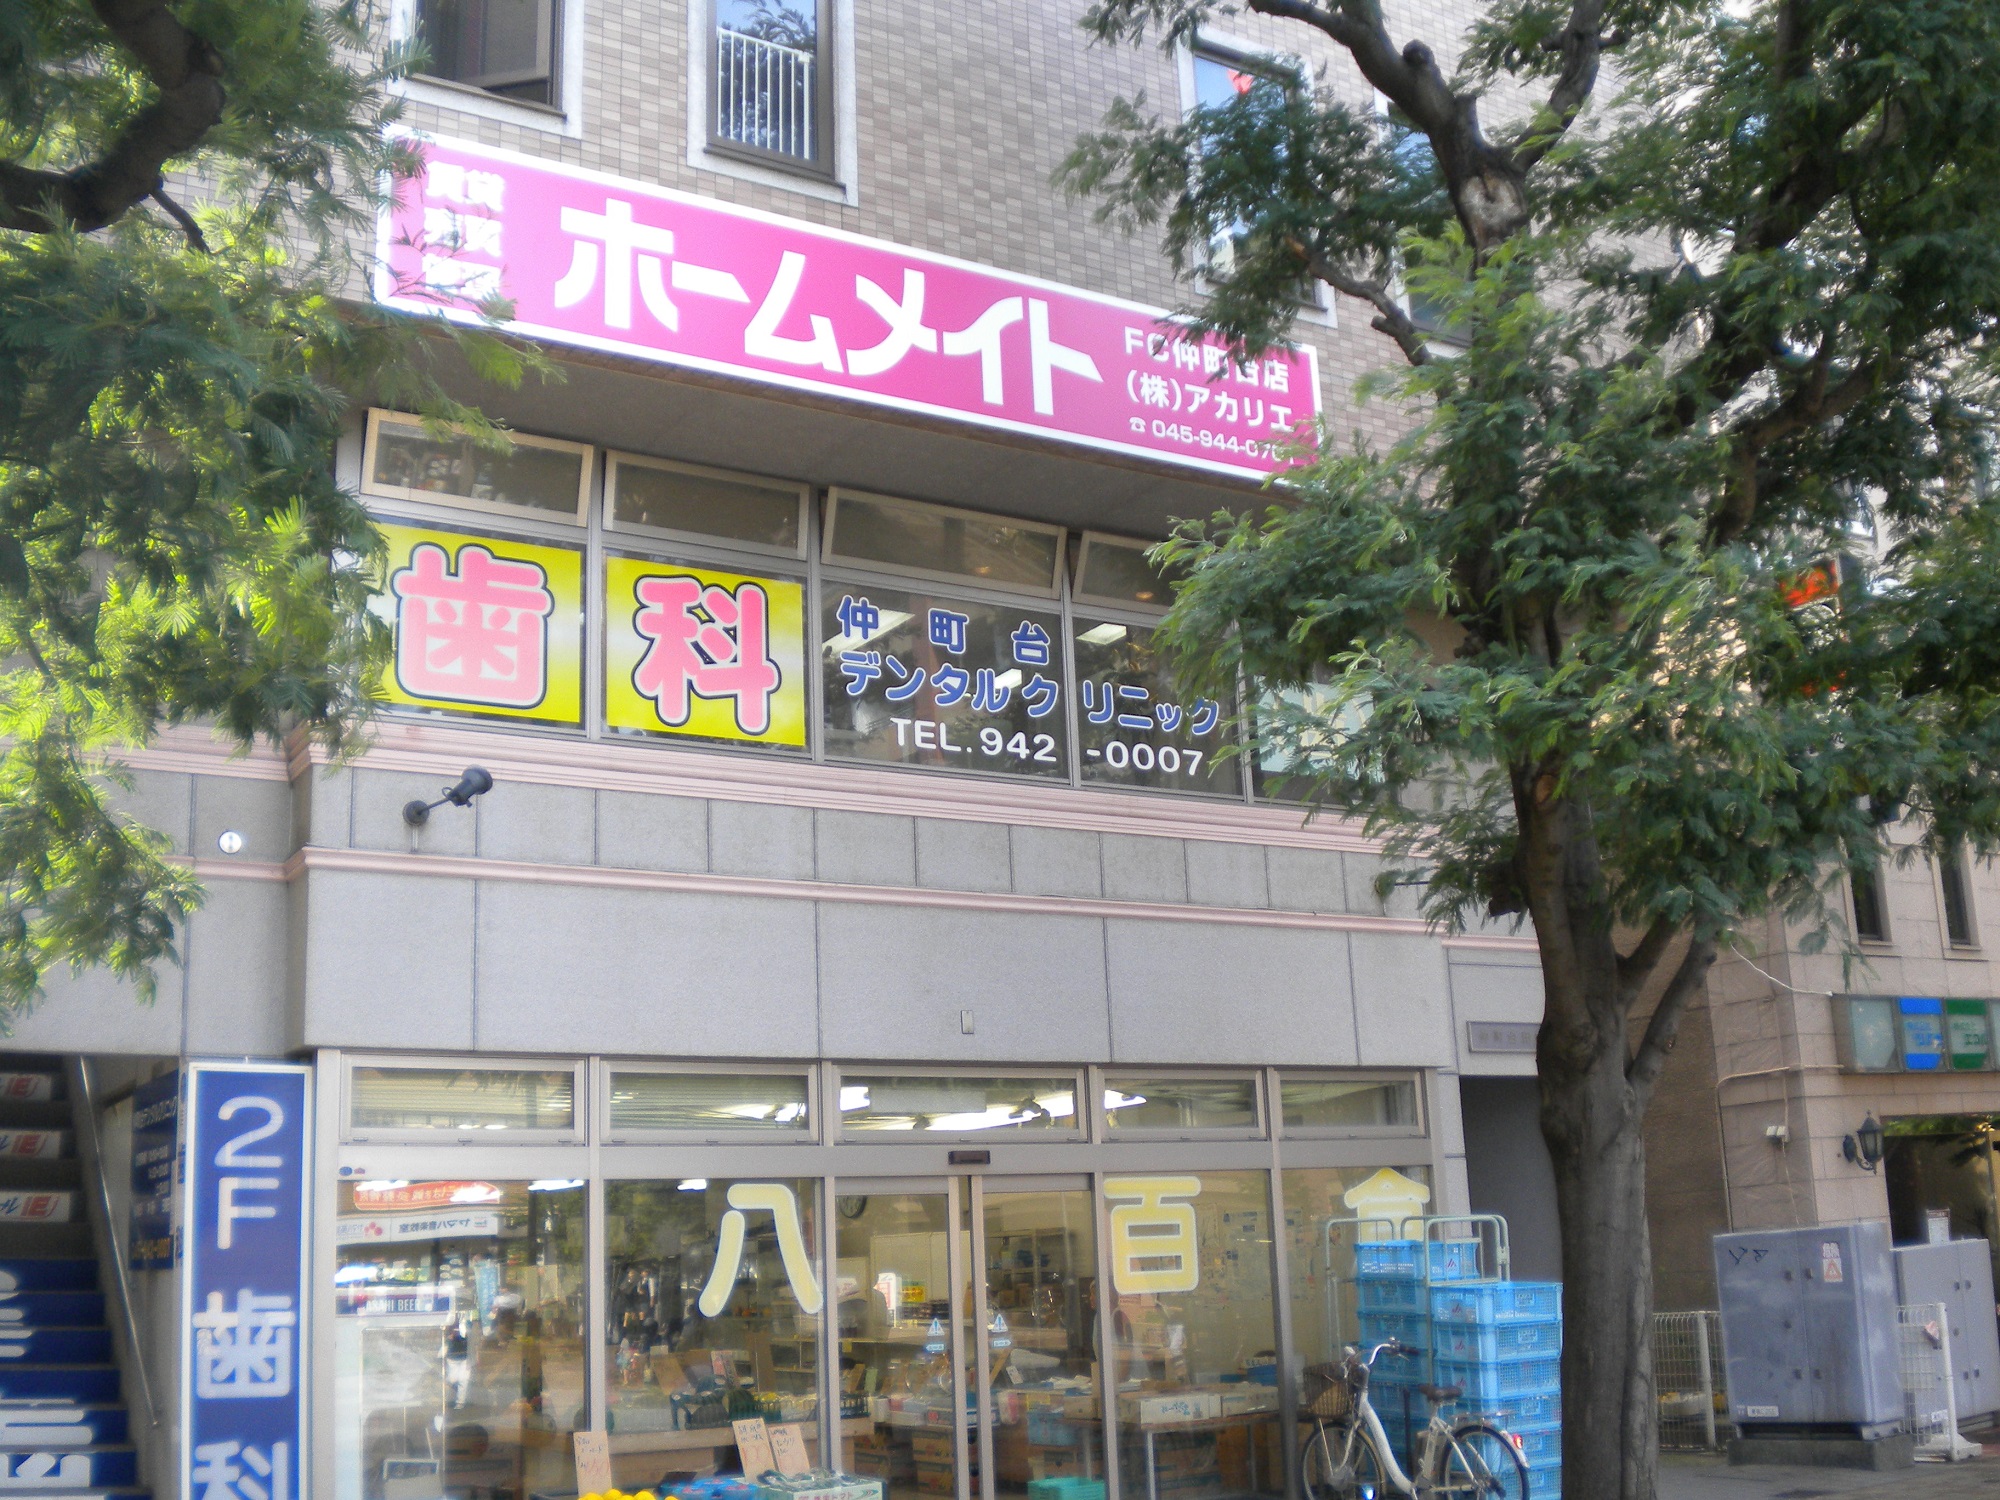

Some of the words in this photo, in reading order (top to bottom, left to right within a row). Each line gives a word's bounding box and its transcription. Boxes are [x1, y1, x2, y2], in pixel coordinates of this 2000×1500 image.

[553, 197, 1104, 416] ホームメイト
[1126, 369, 1293, 433] (株)アカリエ
[391, 541, 782, 736] 歯科
[835, 594, 1050, 666] 仲町台
[839, 649, 1220, 736] デンタルクリニック
[213, 1095, 285, 1250] 2F
[192, 1287, 296, 1500] 歯科
